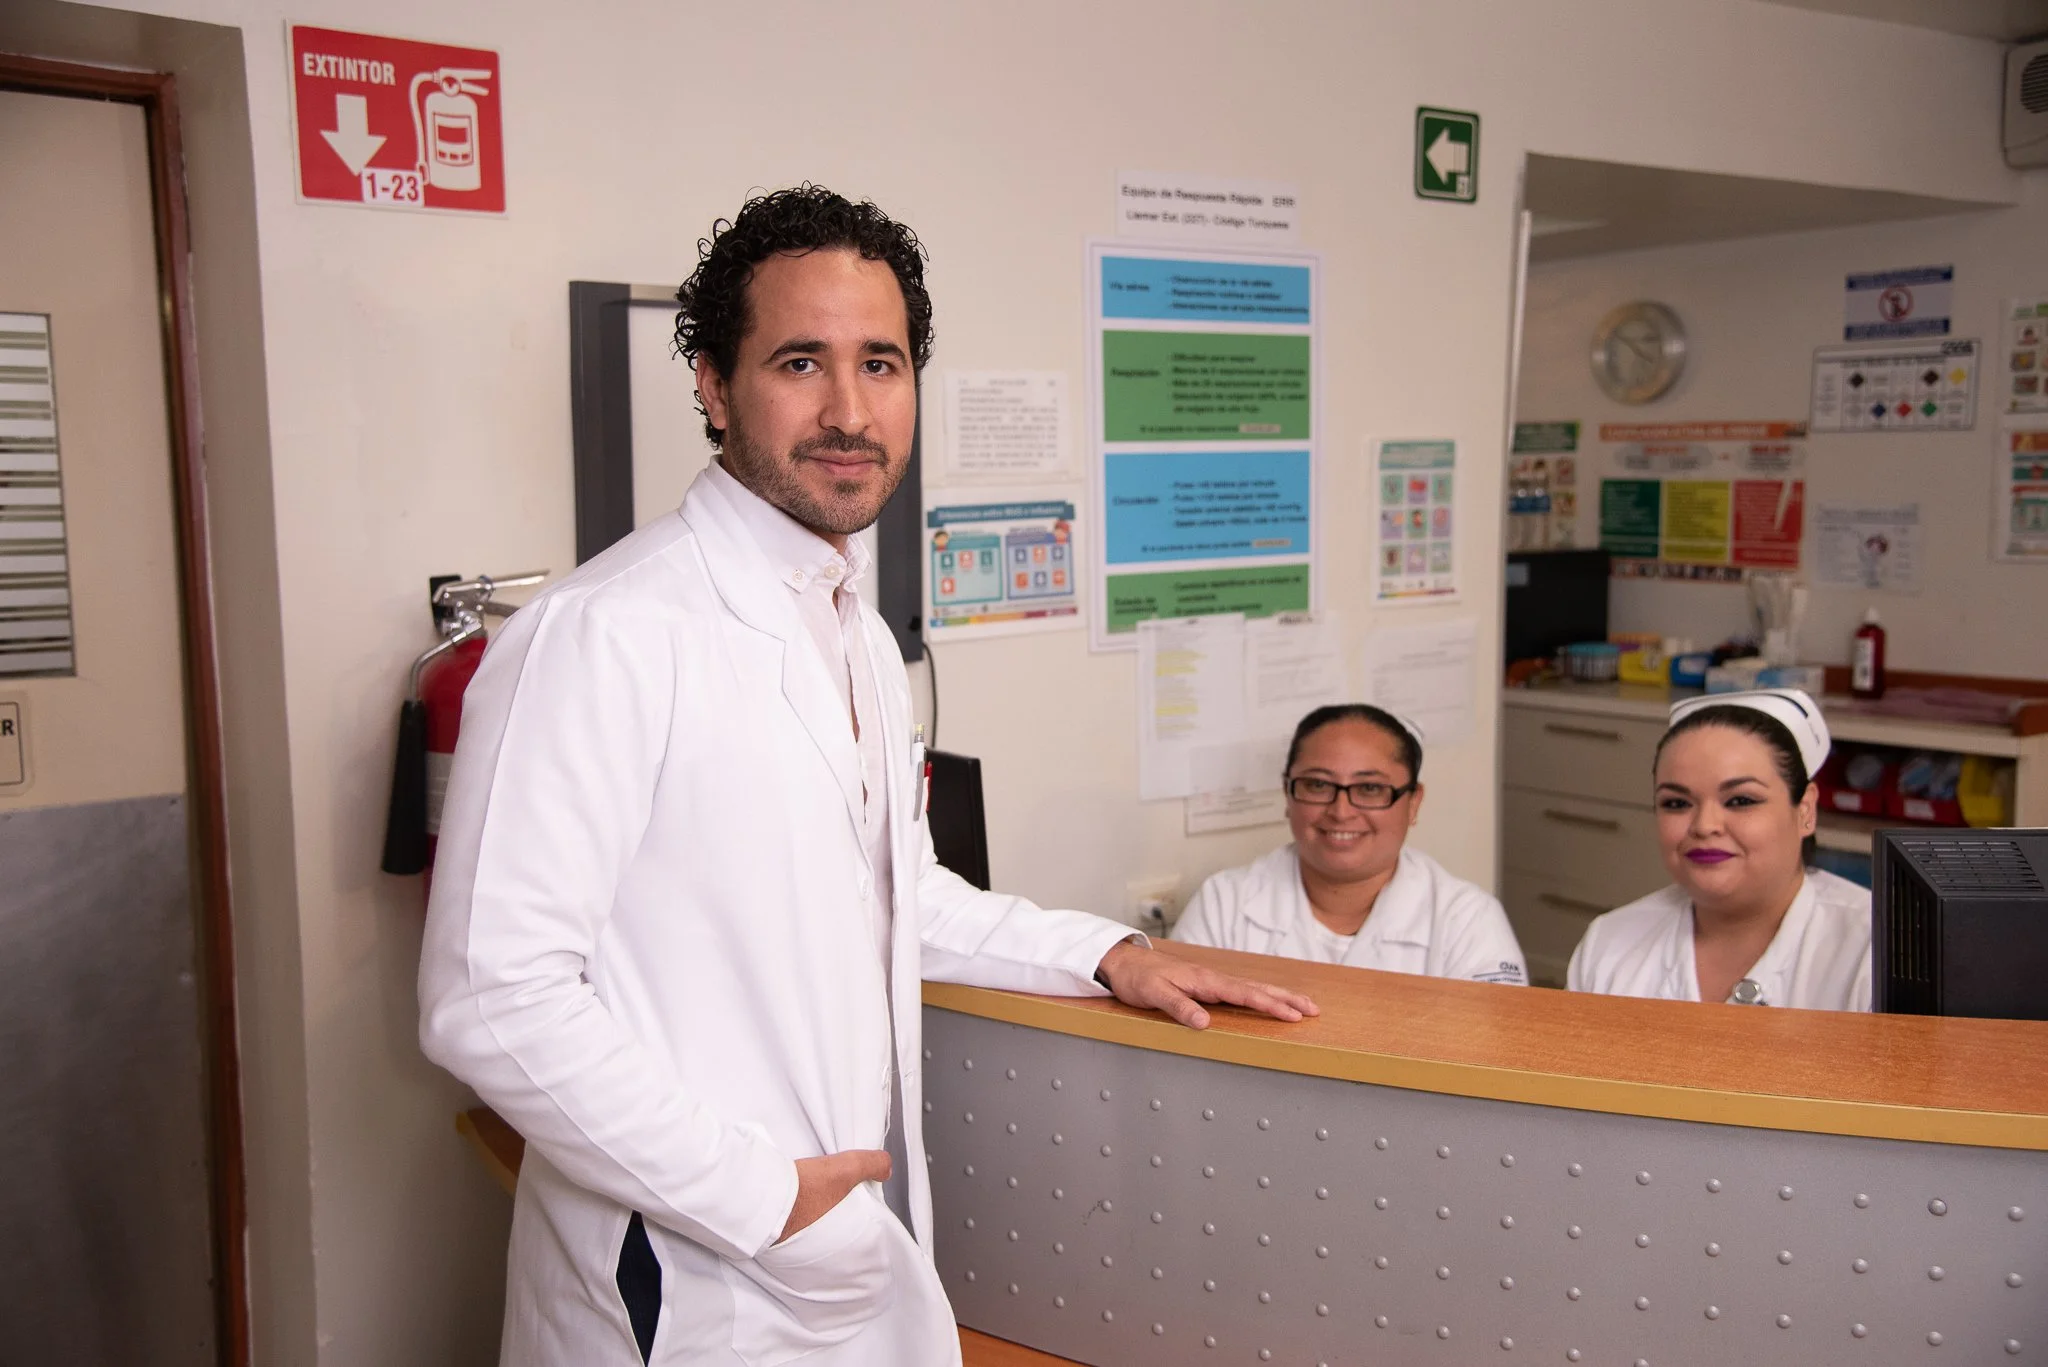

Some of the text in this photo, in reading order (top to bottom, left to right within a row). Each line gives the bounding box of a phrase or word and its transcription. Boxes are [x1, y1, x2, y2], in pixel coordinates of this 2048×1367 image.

[303, 52, 396, 86] EXTINTOR
[366, 172, 419, 201] 1-23
[1121, 184, 1156, 199] Equipo
